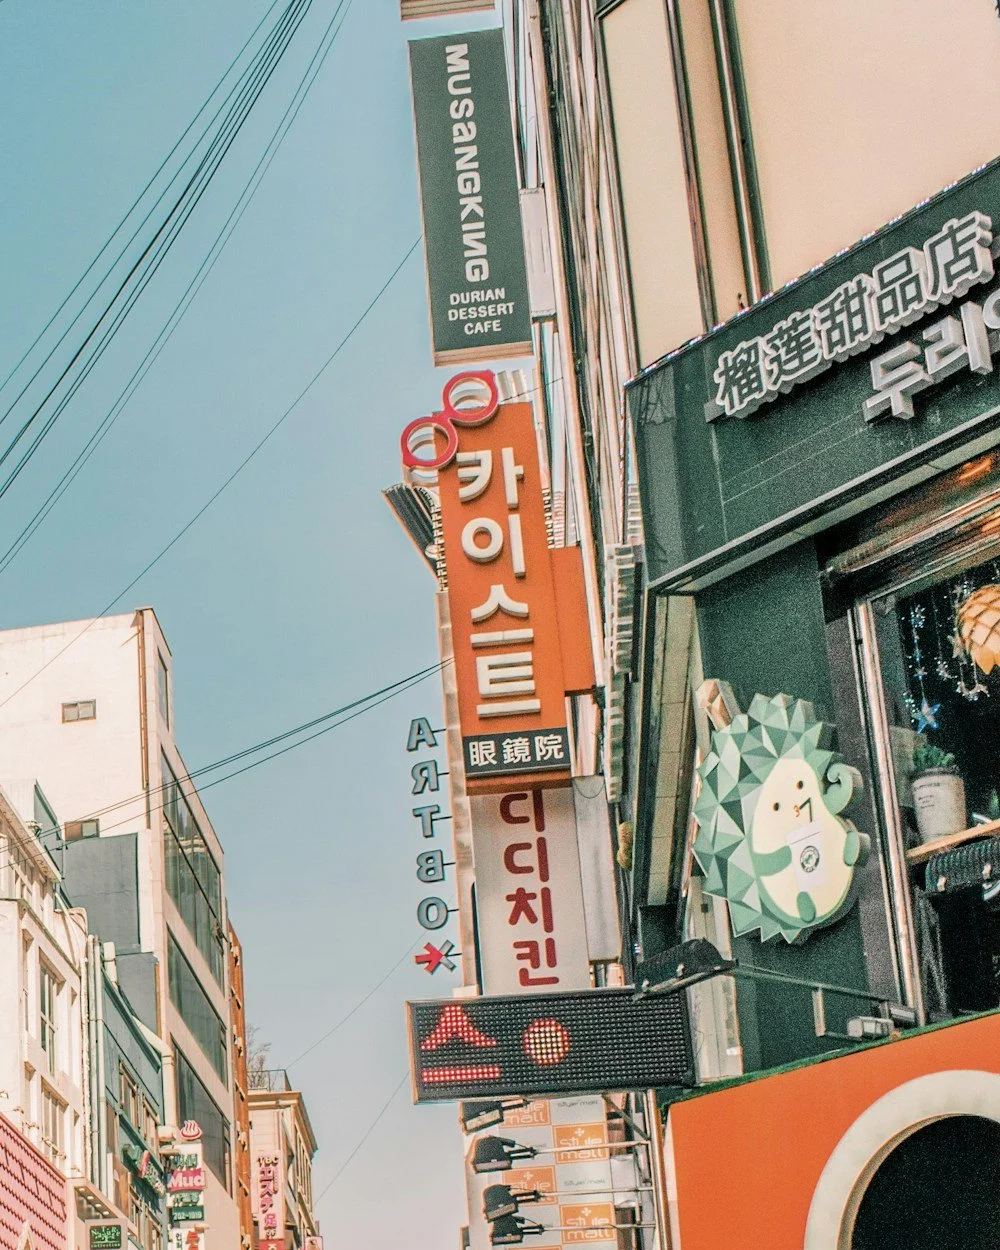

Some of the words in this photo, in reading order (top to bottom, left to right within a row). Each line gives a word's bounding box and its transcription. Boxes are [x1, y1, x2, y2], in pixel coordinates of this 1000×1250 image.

[450, 287, 506, 305] DURIAN
[448, 302, 515, 322] DESSERT
[464, 319, 502, 336] CAFE
[456, 447, 542, 720] 카이스트
[468, 735, 565, 767] 眼鏡院
[500, 788, 560, 988] 디디치킨
[168, 1171, 206, 1188] Mud
